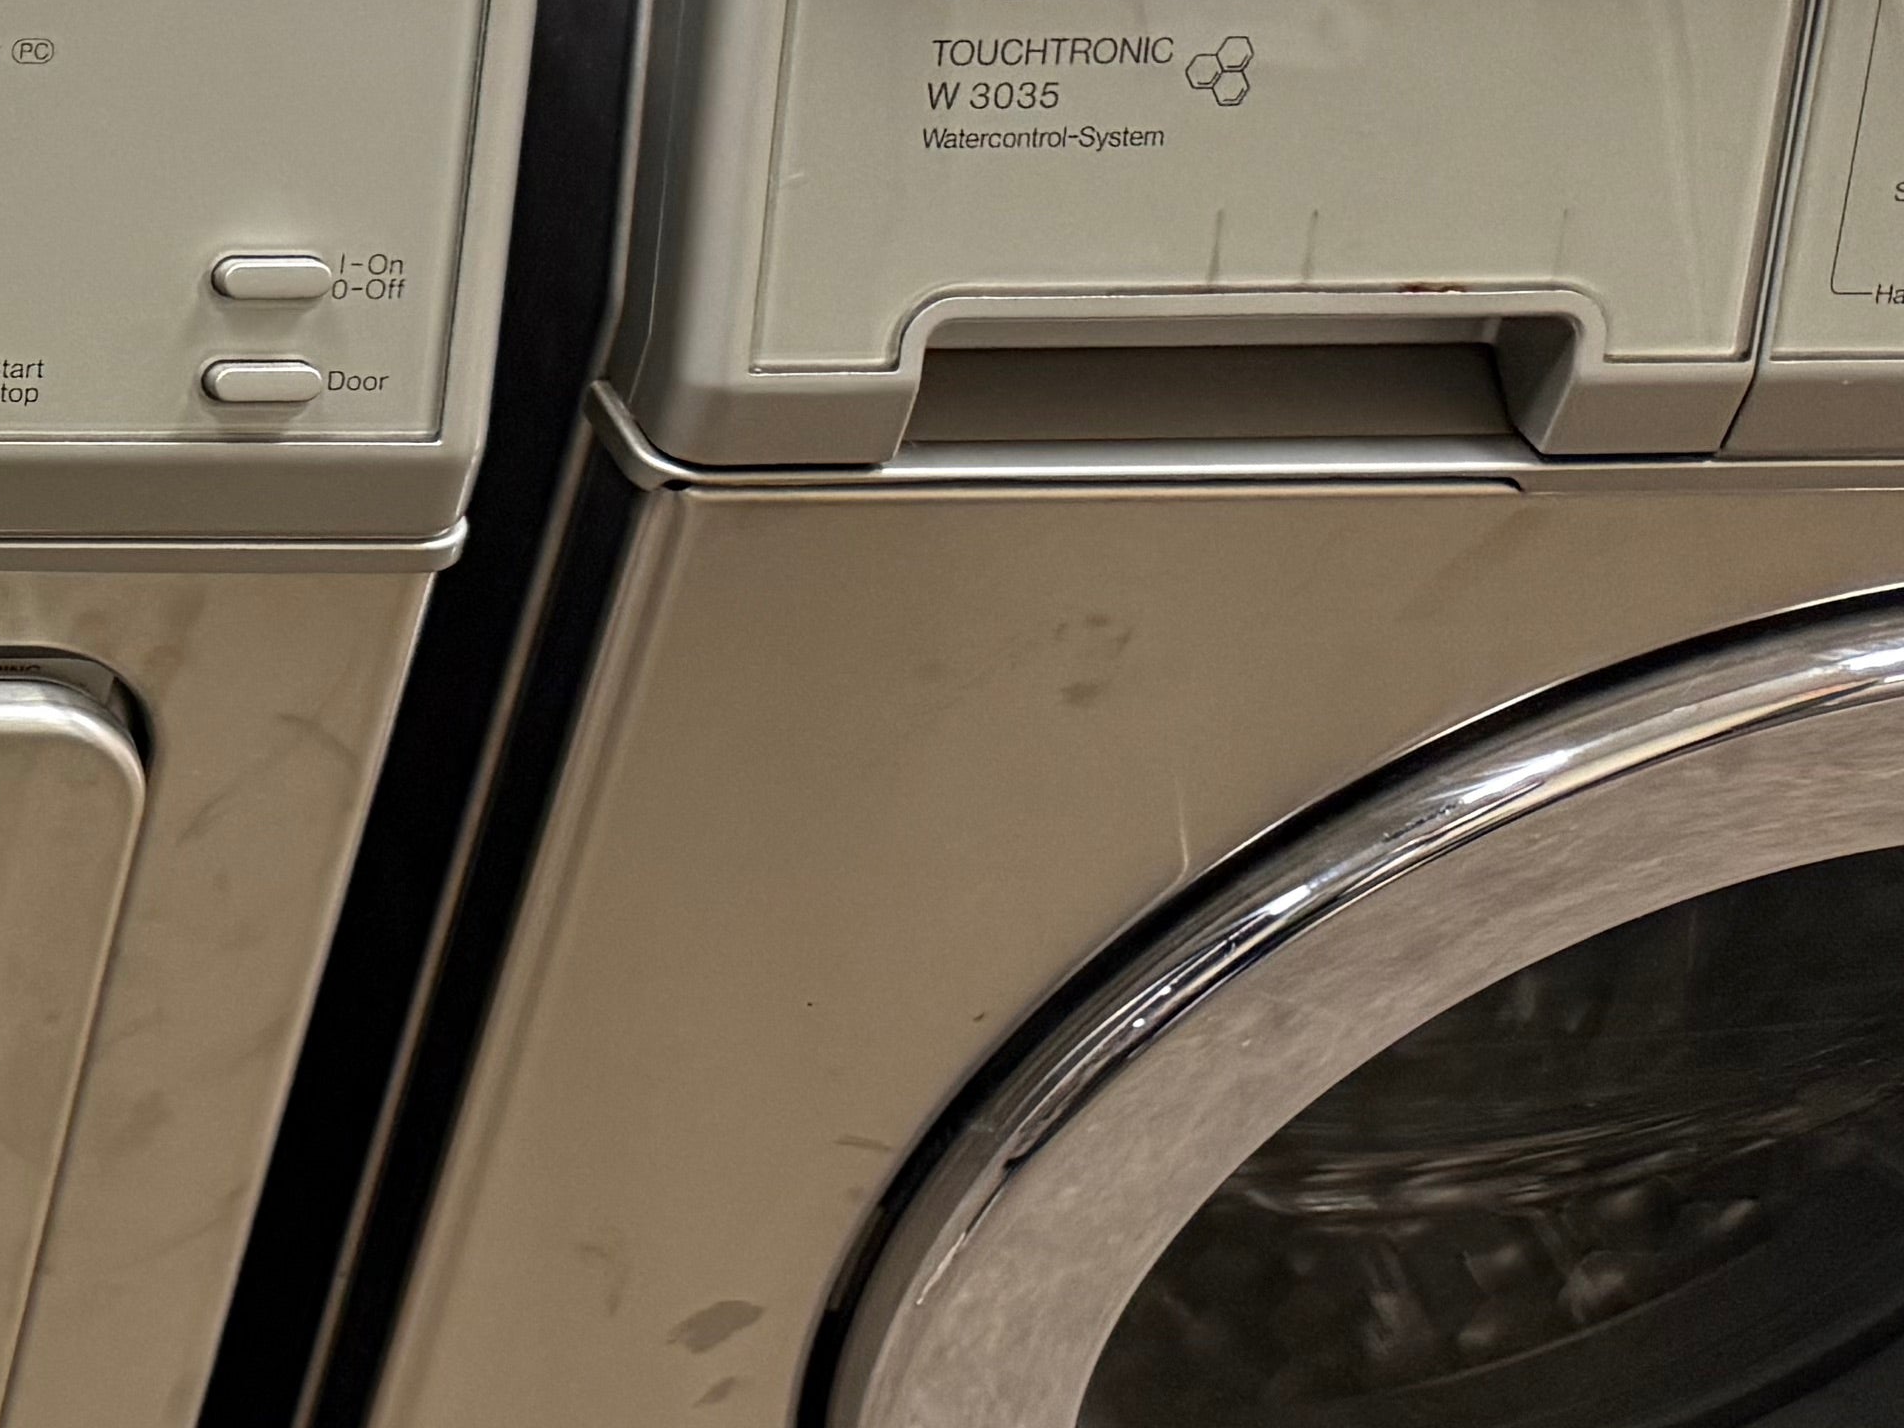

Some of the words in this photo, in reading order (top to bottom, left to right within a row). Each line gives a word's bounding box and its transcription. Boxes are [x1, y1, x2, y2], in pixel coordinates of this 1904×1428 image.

[19, 43, 50, 60] PC
[933, 37, 1173, 66] TOUCHTRONIC
[928, 82, 960, 110] W
[970, 82, 1059, 109] 3035
[923, 126, 1164, 151] Watercontrol-System
[328, 371, 389, 391] Door
